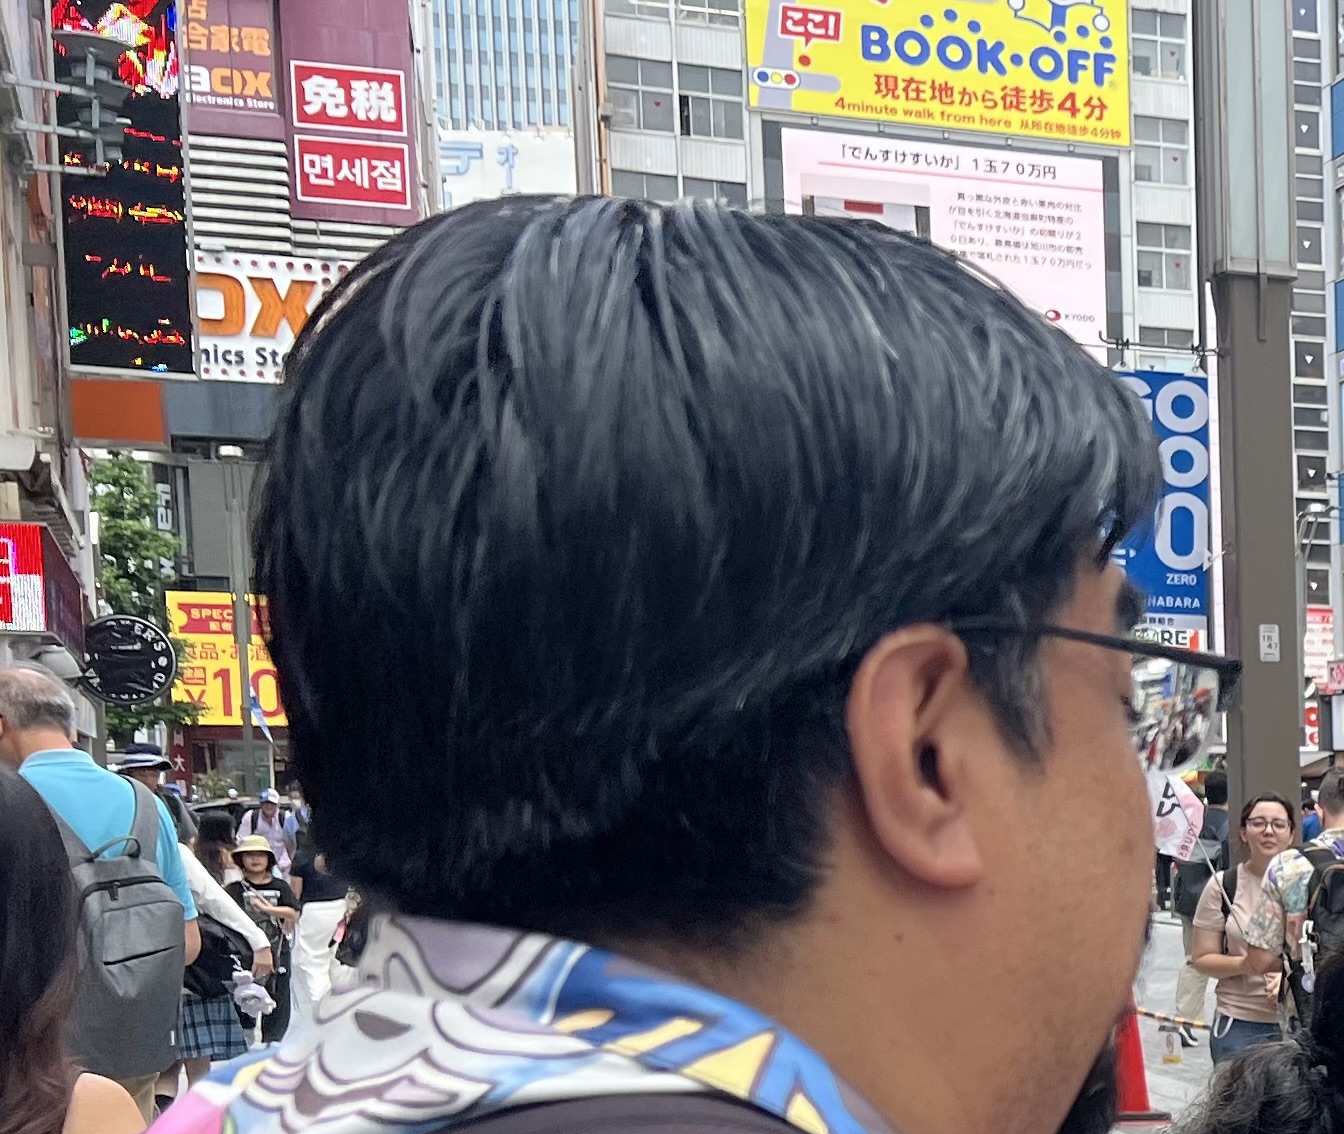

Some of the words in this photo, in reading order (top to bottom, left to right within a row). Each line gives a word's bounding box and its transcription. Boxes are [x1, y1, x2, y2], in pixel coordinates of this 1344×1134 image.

[301, 74, 397, 123] 免税
[834, 97, 898, 117] 4minute
[902, 105, 934, 119] walk
[940, 110, 975, 125] from
[979, 114, 1012, 129] here
[874, 73, 1109, 121] 現在地から徒歩4分
[303, 153, 403, 192] 면세점
[1165, 573, 1197, 585] ZERO
[1147, 596, 1200, 609] HABARA
